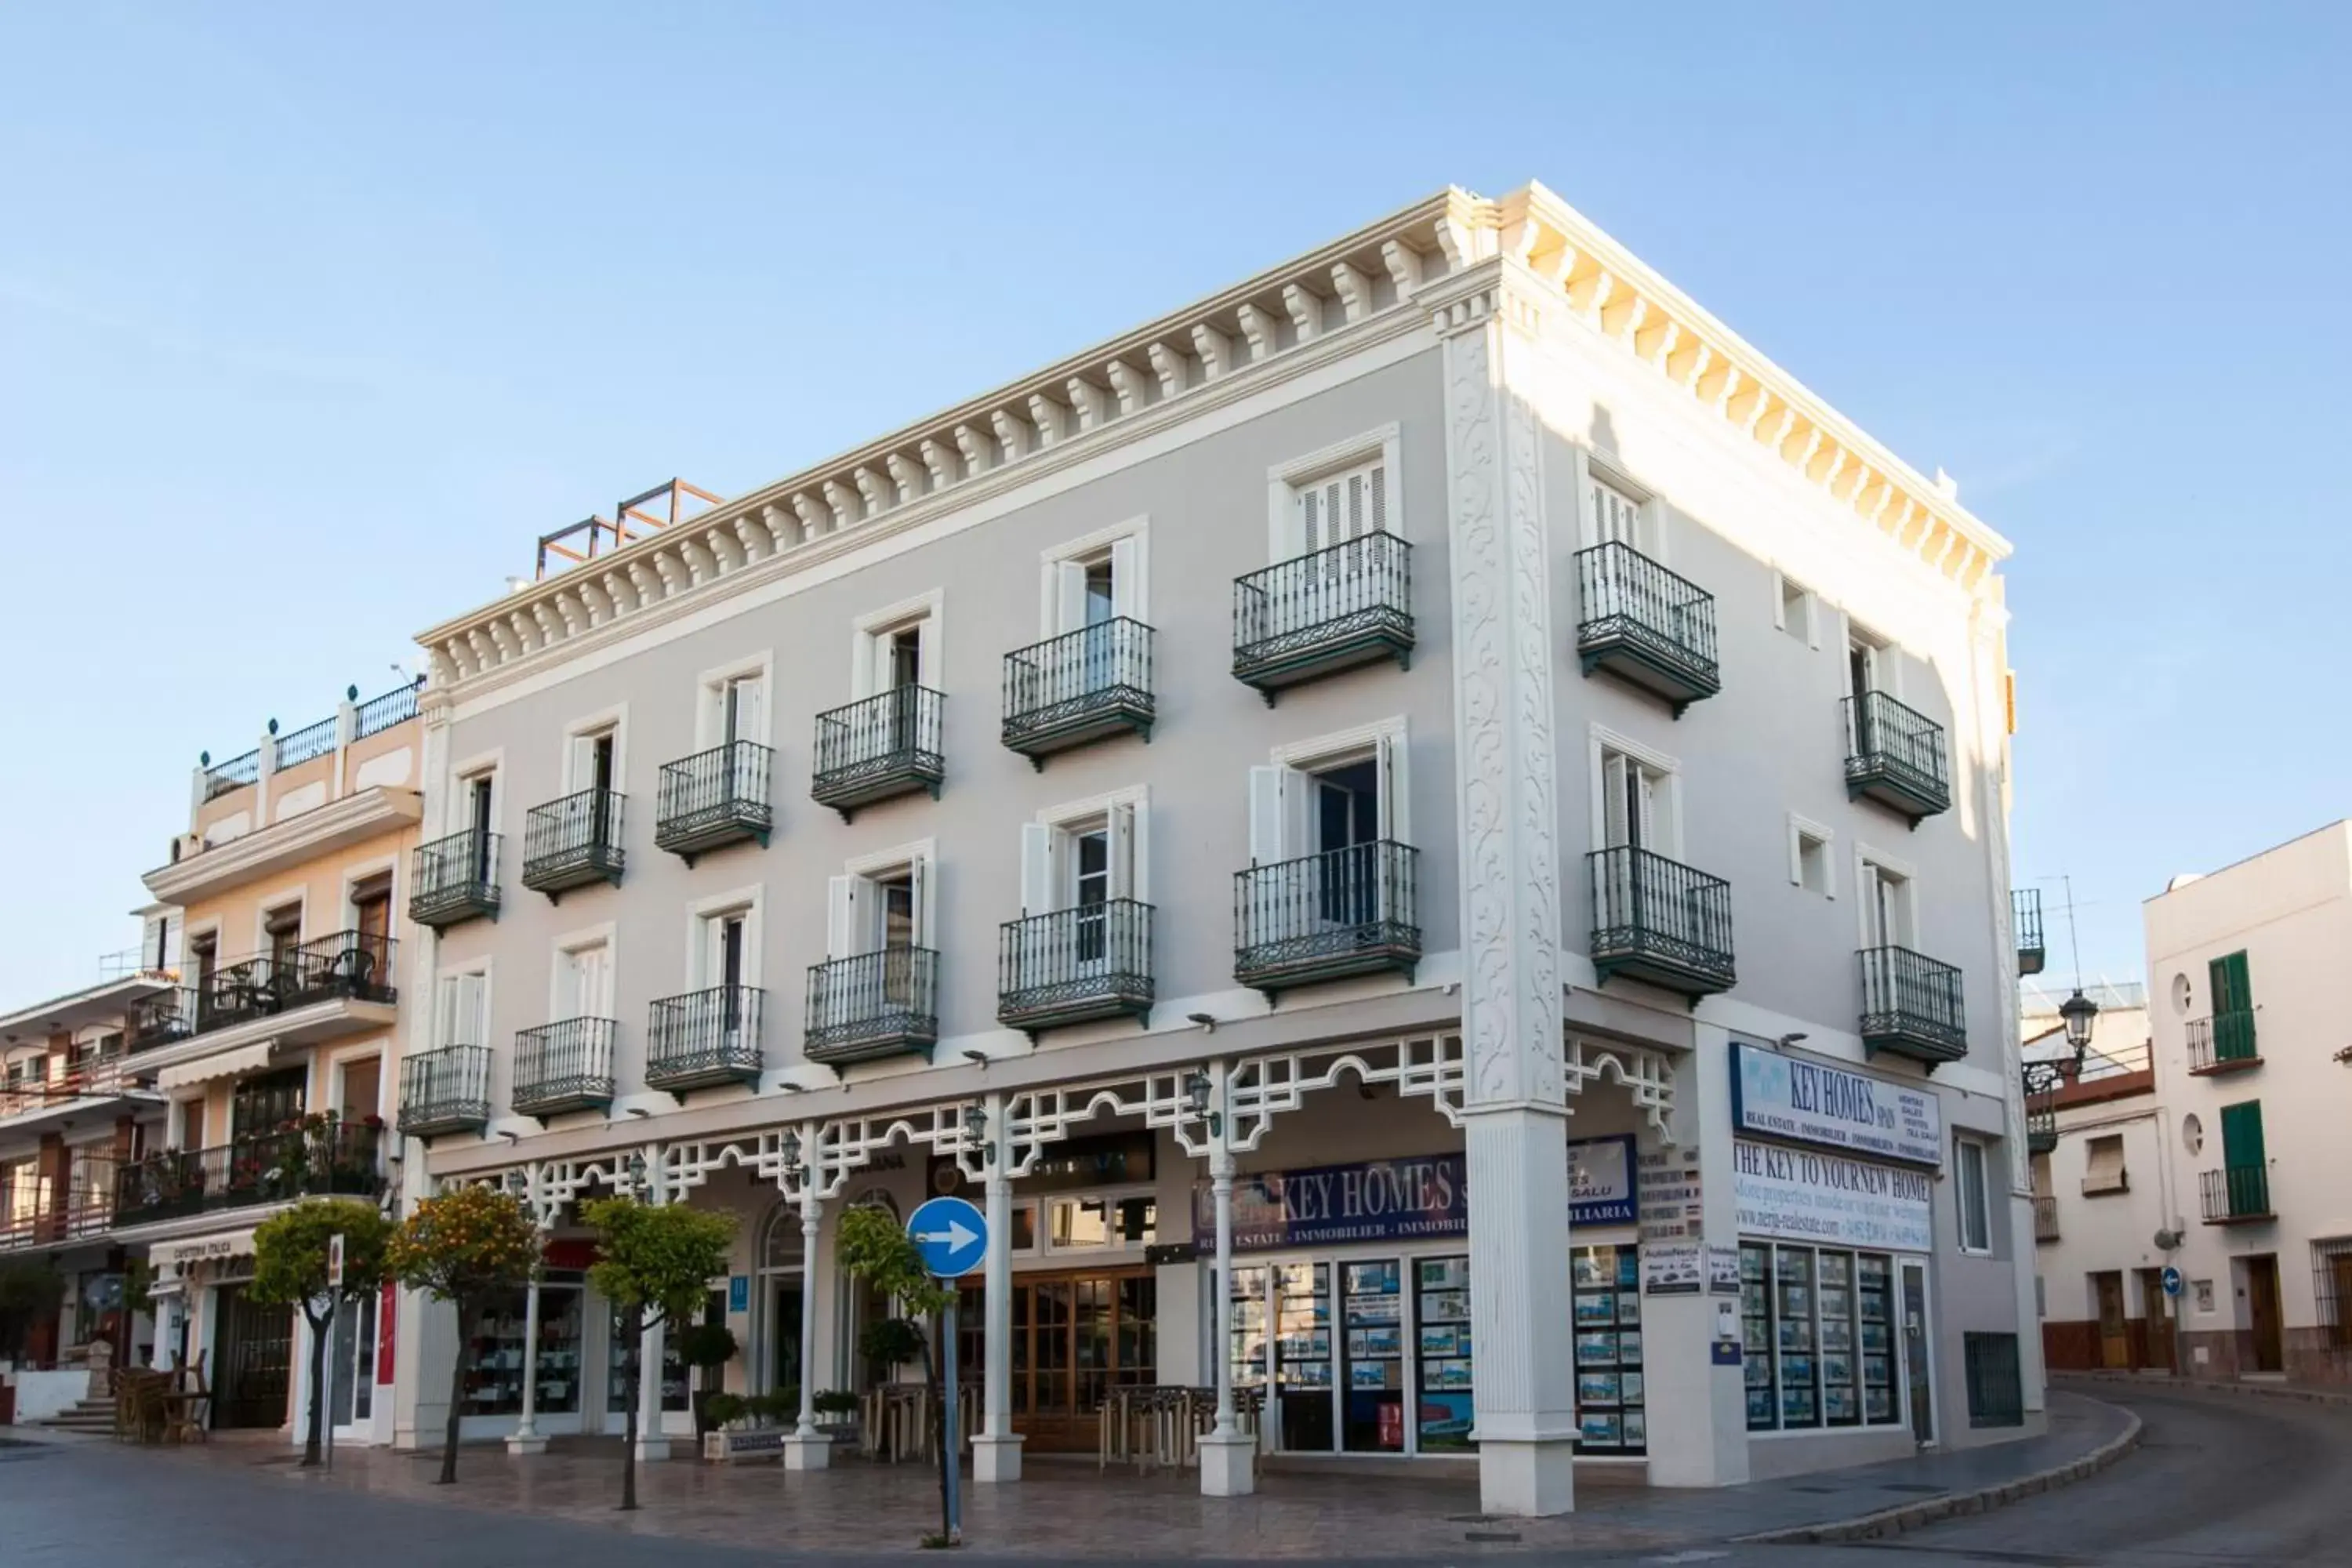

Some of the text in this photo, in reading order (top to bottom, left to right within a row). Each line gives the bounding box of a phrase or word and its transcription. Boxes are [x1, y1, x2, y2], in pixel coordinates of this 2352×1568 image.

[1746, 1111, 1766, 1125] REAL
[1768, 1115, 1795, 1132] ESTATE
[1790, 1061, 1819, 1114] KEY
[1824, 1069, 1875, 1126] HOMES
[1278, 1173, 1334, 1222] KEY
[1341, 1161, 1452, 1217] HOMES
[1733, 1142, 1929, 1202] THE KEY TO YOUR NEW HOME
[1236, 1233, 1280, 1247] ESTATE
[1294, 1224, 1385, 1242] IMMOBILIER
